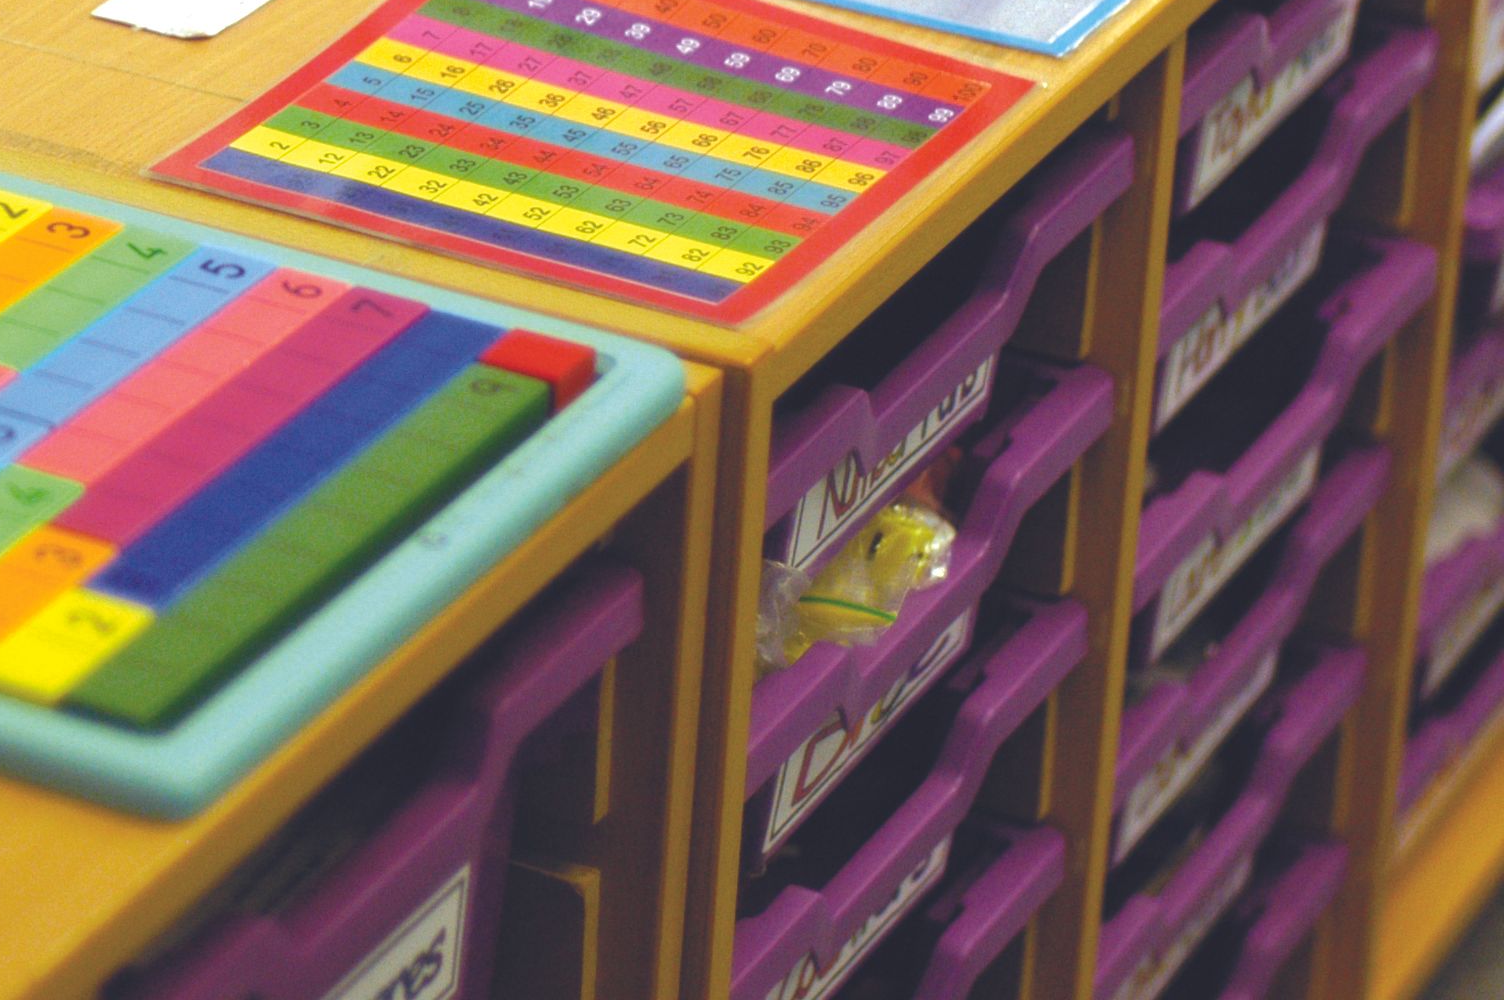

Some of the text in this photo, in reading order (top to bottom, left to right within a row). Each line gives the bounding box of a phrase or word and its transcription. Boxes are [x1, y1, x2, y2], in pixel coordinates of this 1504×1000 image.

[269, 140, 289, 150] 2
[300, 120, 320, 128] 3
[362, 76, 381, 85] 5
[393, 54, 411, 62] 6
[421, 30, 440, 39] 7
[318, 152, 344, 164] 12
[349, 131, 374, 143] 13
[410, 87, 434, 100] 15
[440, 64, 465, 77] 16
[470, 41, 492, 54] 17
[367, 165, 395, 178] 22
[398, 144, 425, 158] 23
[458, 100, 485, 115] 25
[517, 56, 542, 69] 27
[575, 8, 600, 24] 29
[418, 179, 446, 193] 32
[449, 158, 475, 171] 33
[509, 114, 535, 128] 35
[538, 93, 565, 106] 36
[568, 70, 592, 83] 37
[624, 23, 650, 38] 39
[472, 193, 498, 206] 42
[502, 171, 527, 184] 43
[562, 128, 586, 141] 45
[619, 83, 642, 96] 47
[676, 38, 699, 53] 49
[702, 13, 727, 28] 50
[522, 207, 550, 220] 52
[552, 185, 579, 198] 53
[611, 141, 637, 155] 55
[640, 120, 666, 133] 56
[668, 98, 693, 111] 57
[724, 52, 749, 67] 59
[575, 221, 603, 233] 62
[604, 198, 631, 211] 63
[663, 154, 689, 168] 65
[691, 133, 717, 146] 66
[719, 111, 744, 124] 67
[775, 66, 800, 81] 69
[801, 42, 826, 57] 70
[627, 235, 655, 247] 72
[657, 212, 684, 225] 73
[714, 167, 741, 181] 75
[742, 146, 769, 159] 76
[770, 124, 796, 137] 77
[825, 80, 851, 94] 79
[47, 221, 90, 240] 3
[127, 240, 168, 261] 4
[681, 249, 708, 261] 82
[710, 226, 737, 239] 83
[767, 180, 793, 194] 85
[795, 159, 822, 172] 86
[823, 137, 848, 151] 87
[877, 94, 902, 109] 89
[735, 262, 762, 275] 92
[764, 239, 790, 253] 93
[820, 193, 846, 208] 95
[848, 172, 874, 185] 96
[874, 150, 900, 164] 97
[928, 107, 953, 121] 99
[201, 259, 246, 280] 5
[282, 279, 324, 300] 6
[351, 299, 394, 318] 7
